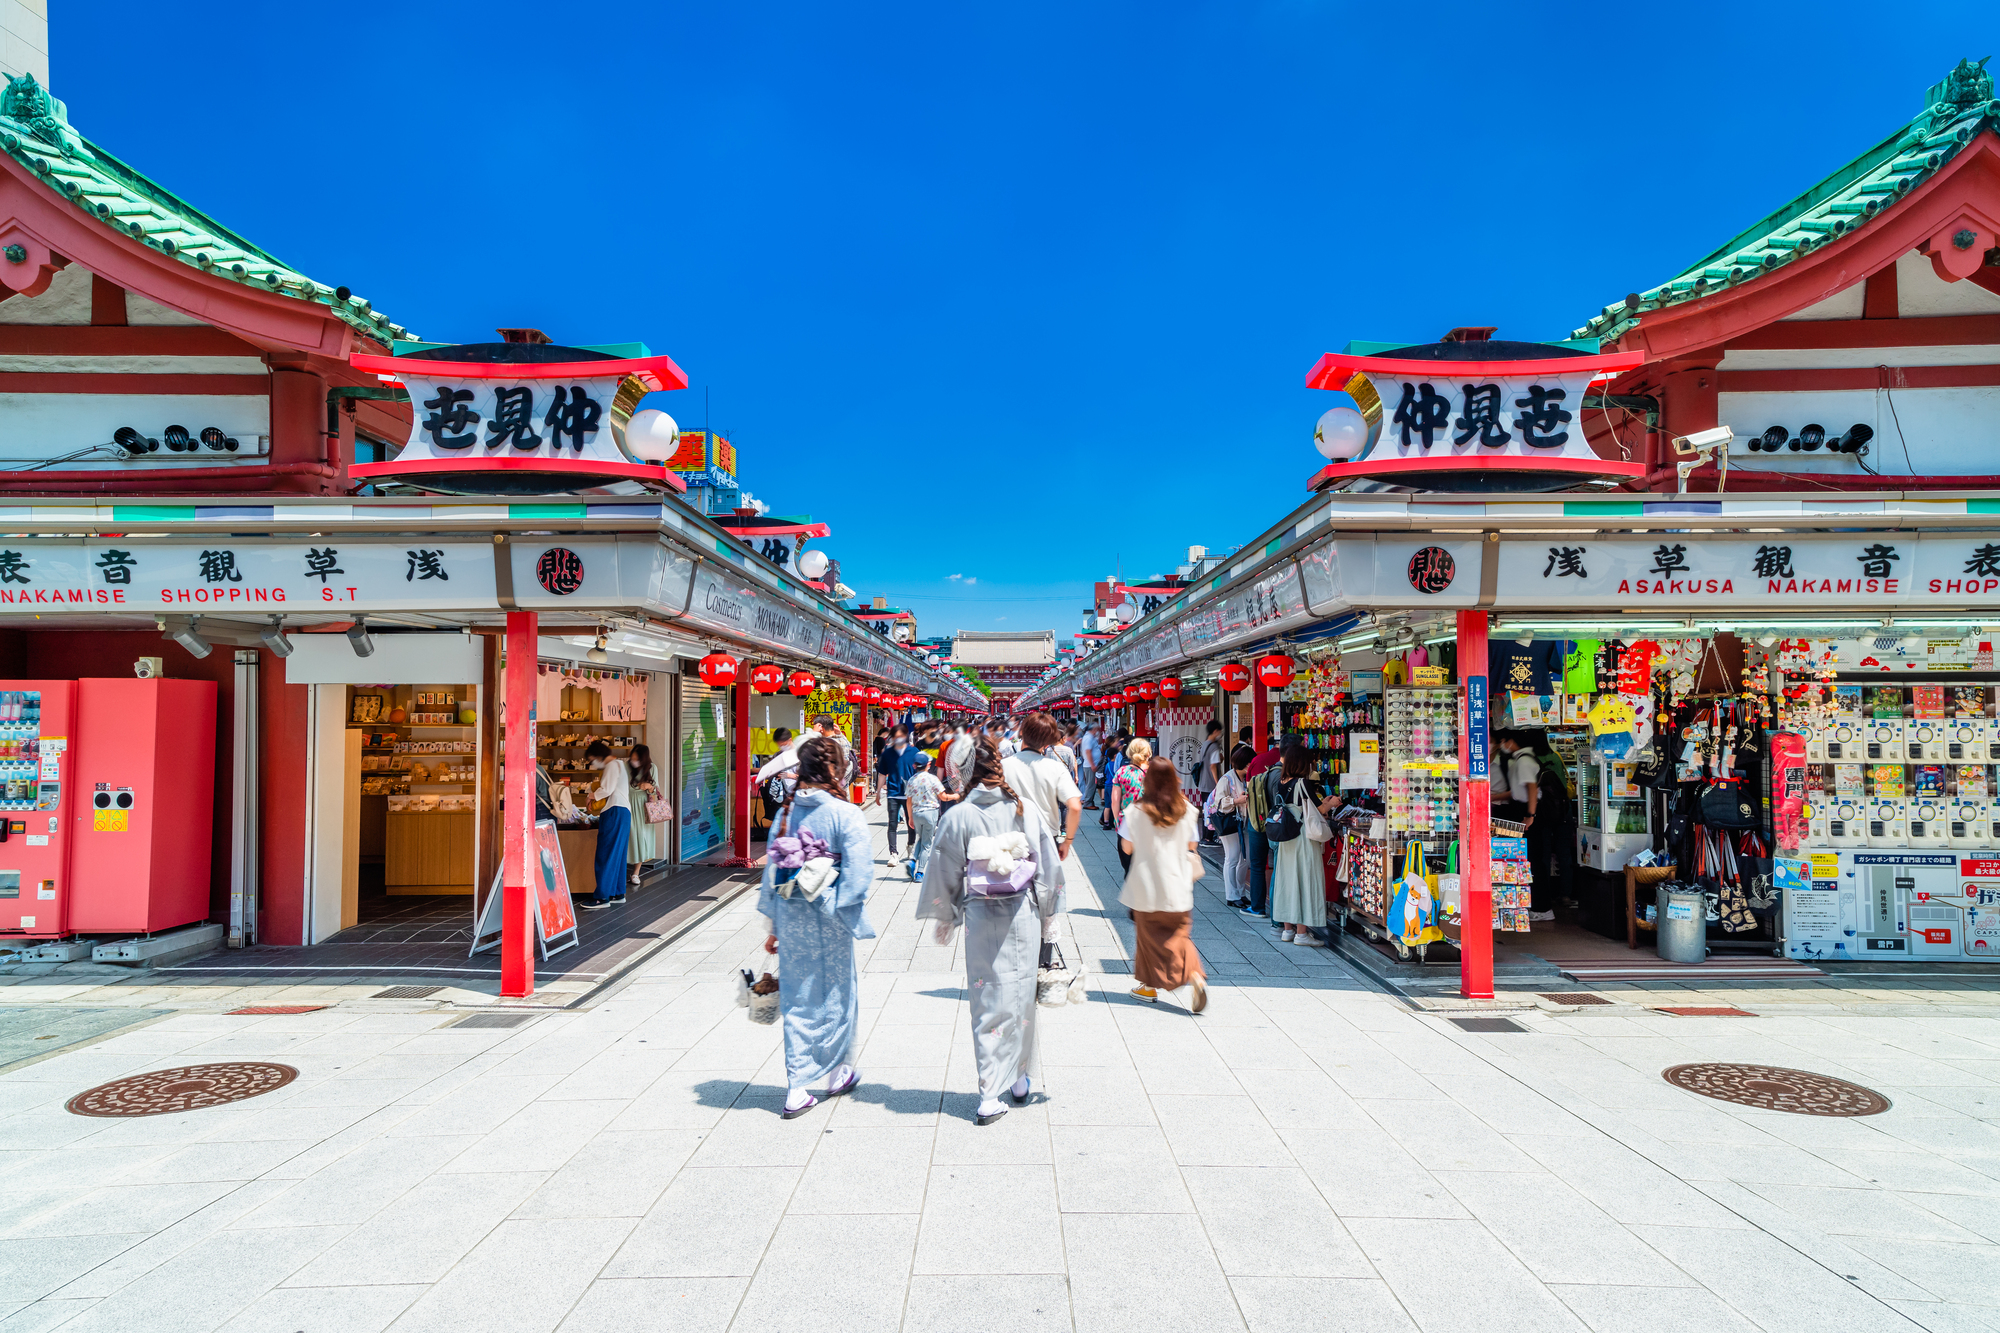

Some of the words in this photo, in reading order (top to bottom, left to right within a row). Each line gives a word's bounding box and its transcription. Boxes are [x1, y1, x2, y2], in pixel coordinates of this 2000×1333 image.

[1393, 382, 1572, 449] 仲見世
[1618, 580, 1735, 594] ASAKUSA
[1768, 579, 1899, 594] NAKAMISE
[1, 590, 126, 603] NAKAMISE
[160, 587, 286, 602] SHOPPING
[705, 583, 742, 622] Cosmetics
[754, 606, 790, 638] MONKADO
[1472, 761, 1485, 772] 18
[1784, 768, 1804, 799] 雷門
[1878, 940, 1894, 948] 雷門
